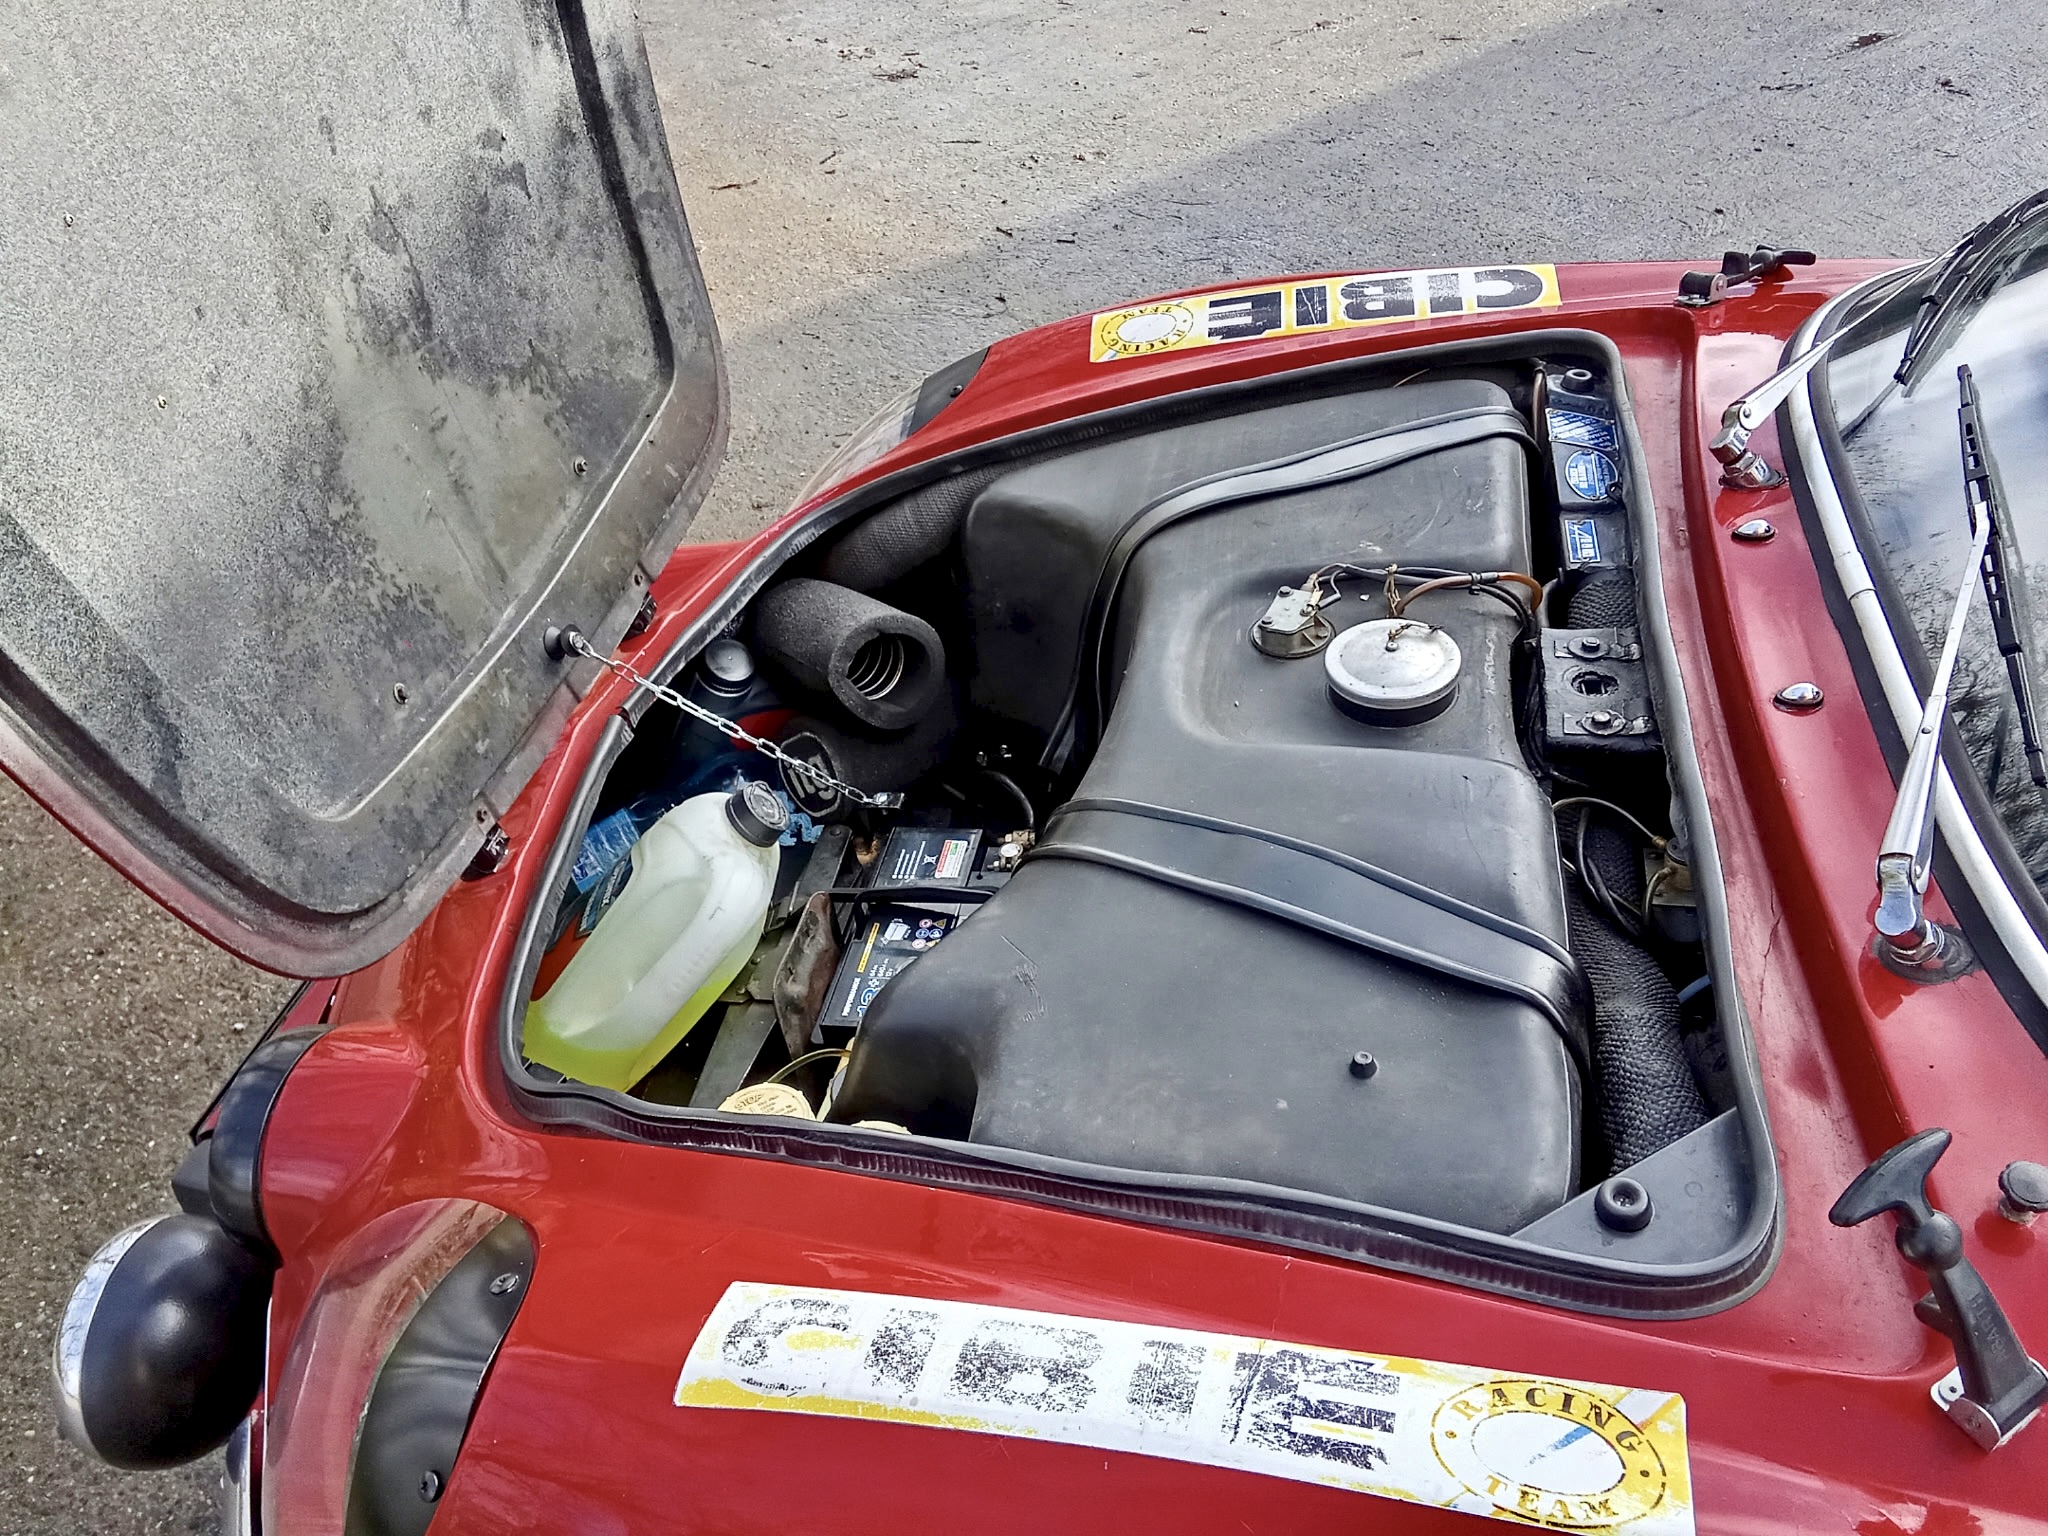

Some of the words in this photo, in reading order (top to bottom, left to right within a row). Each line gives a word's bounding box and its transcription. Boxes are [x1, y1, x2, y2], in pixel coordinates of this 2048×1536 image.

[1122, 306, 1172, 319] TEAM
[1108, 329, 1186, 352] RACING
[1450, 1387, 1643, 1453] RACING
[1485, 1475, 1619, 1520] TEAM
